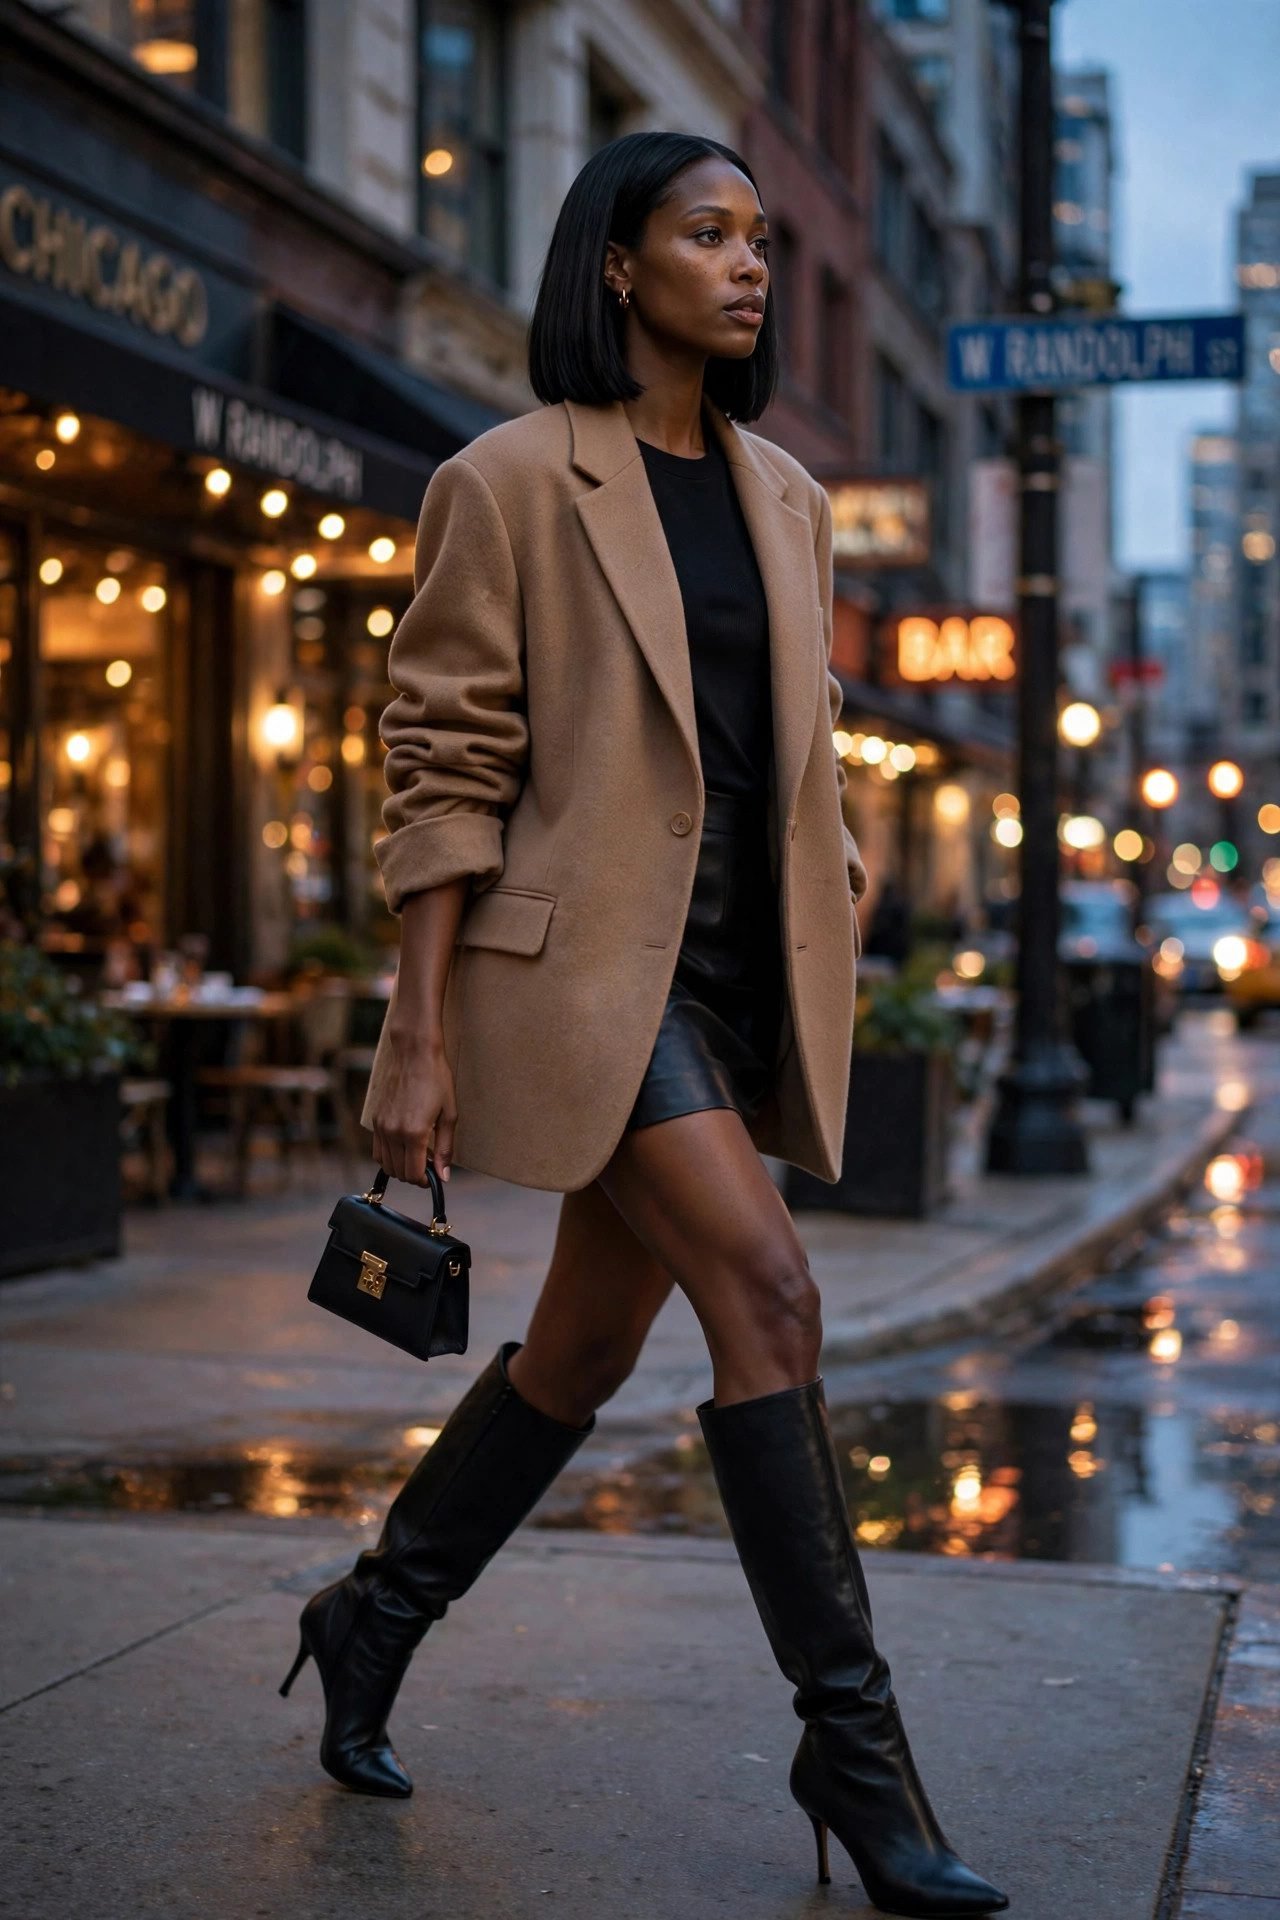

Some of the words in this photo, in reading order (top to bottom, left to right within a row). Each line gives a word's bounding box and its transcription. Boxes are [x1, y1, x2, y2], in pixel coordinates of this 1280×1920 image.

[1, 184, 208, 346] CHICAGO
[958, 333, 994, 381] W
[1004, 323, 1193, 381] RANDOLPH
[192, 387, 224, 449] W
[226, 400, 362, 499] RANDOLPH
[898, 616, 1016, 681] BAR
